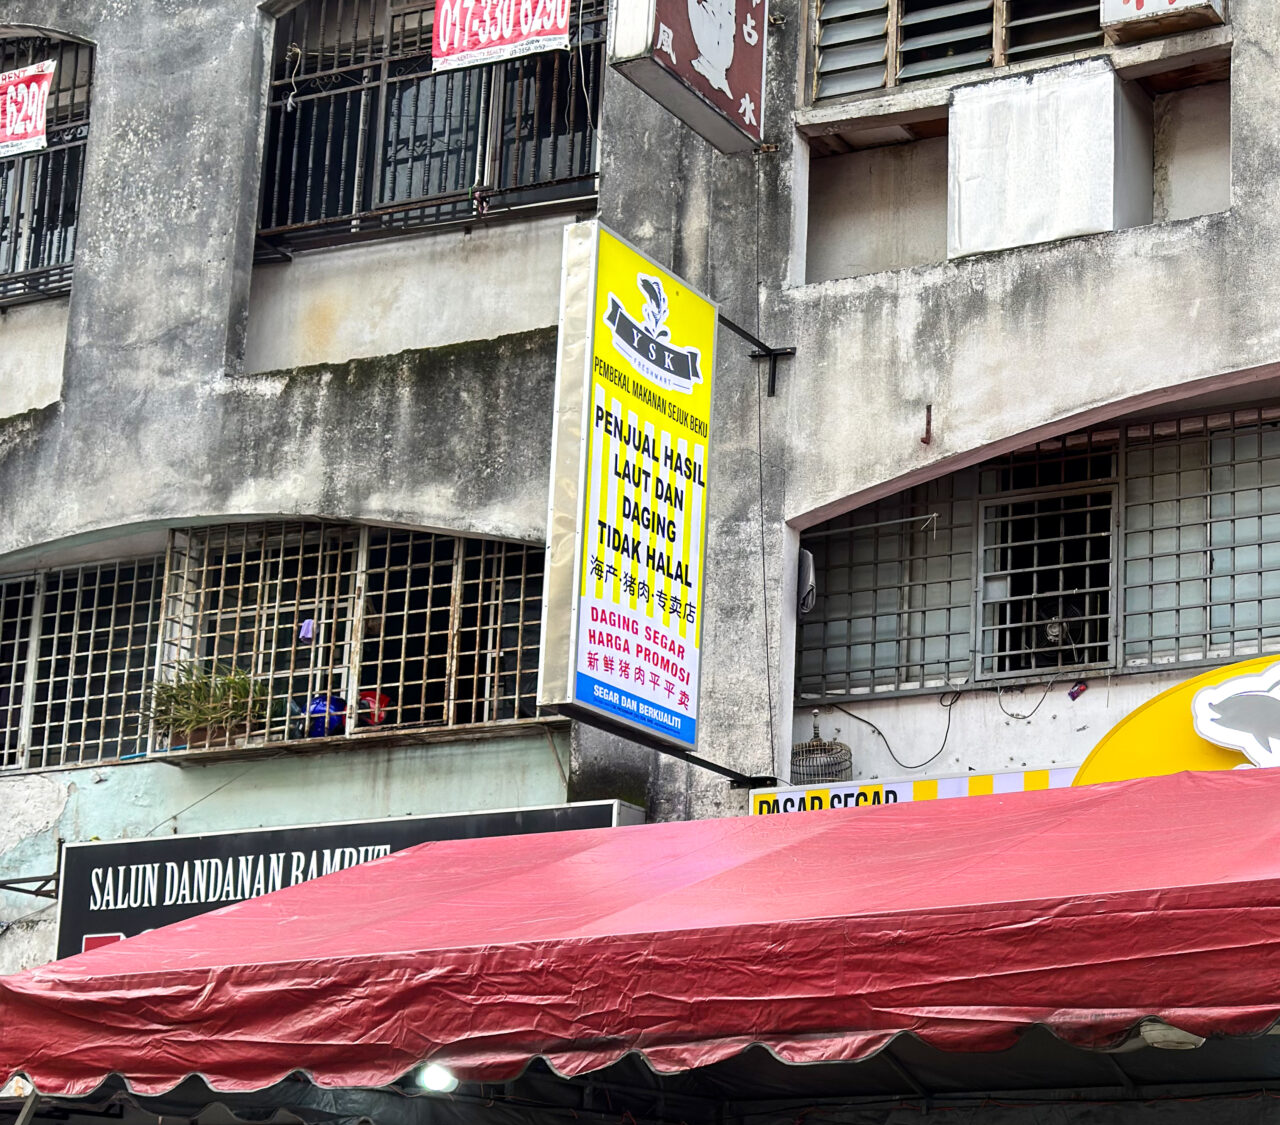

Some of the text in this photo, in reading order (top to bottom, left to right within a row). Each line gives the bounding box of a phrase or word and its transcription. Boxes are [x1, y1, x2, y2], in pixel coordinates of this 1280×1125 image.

[439, 0, 514, 51] 017-330
[6, 80, 49, 136] 6290
[632, 328, 674, 371] YSK
[633, 357, 672, 386] FRESHMART
[594, 356, 708, 439] PEMBEKAL MAKANAN SEJUK BEKU
[595, 404, 706, 488] PENJUAL HASIL
[614, 453, 684, 512] LAUT DAN
[622, 495, 677, 543] DAGING
[597, 519, 693, 588] TIDAK HALAL
[588, 628, 691, 686] HARGA PROMOSI
[590, 606, 686, 661] DAGING SEGAR
[587, 650, 690, 711] 新鲜猪肉平平卖
[593, 684, 620, 705] SEGAR
[621, 695, 638, 712] DAN
[639, 702, 681, 730] BERKUALITI
[89, 863, 161, 911] SALUN
[163, 853, 286, 906] DANDANAN
